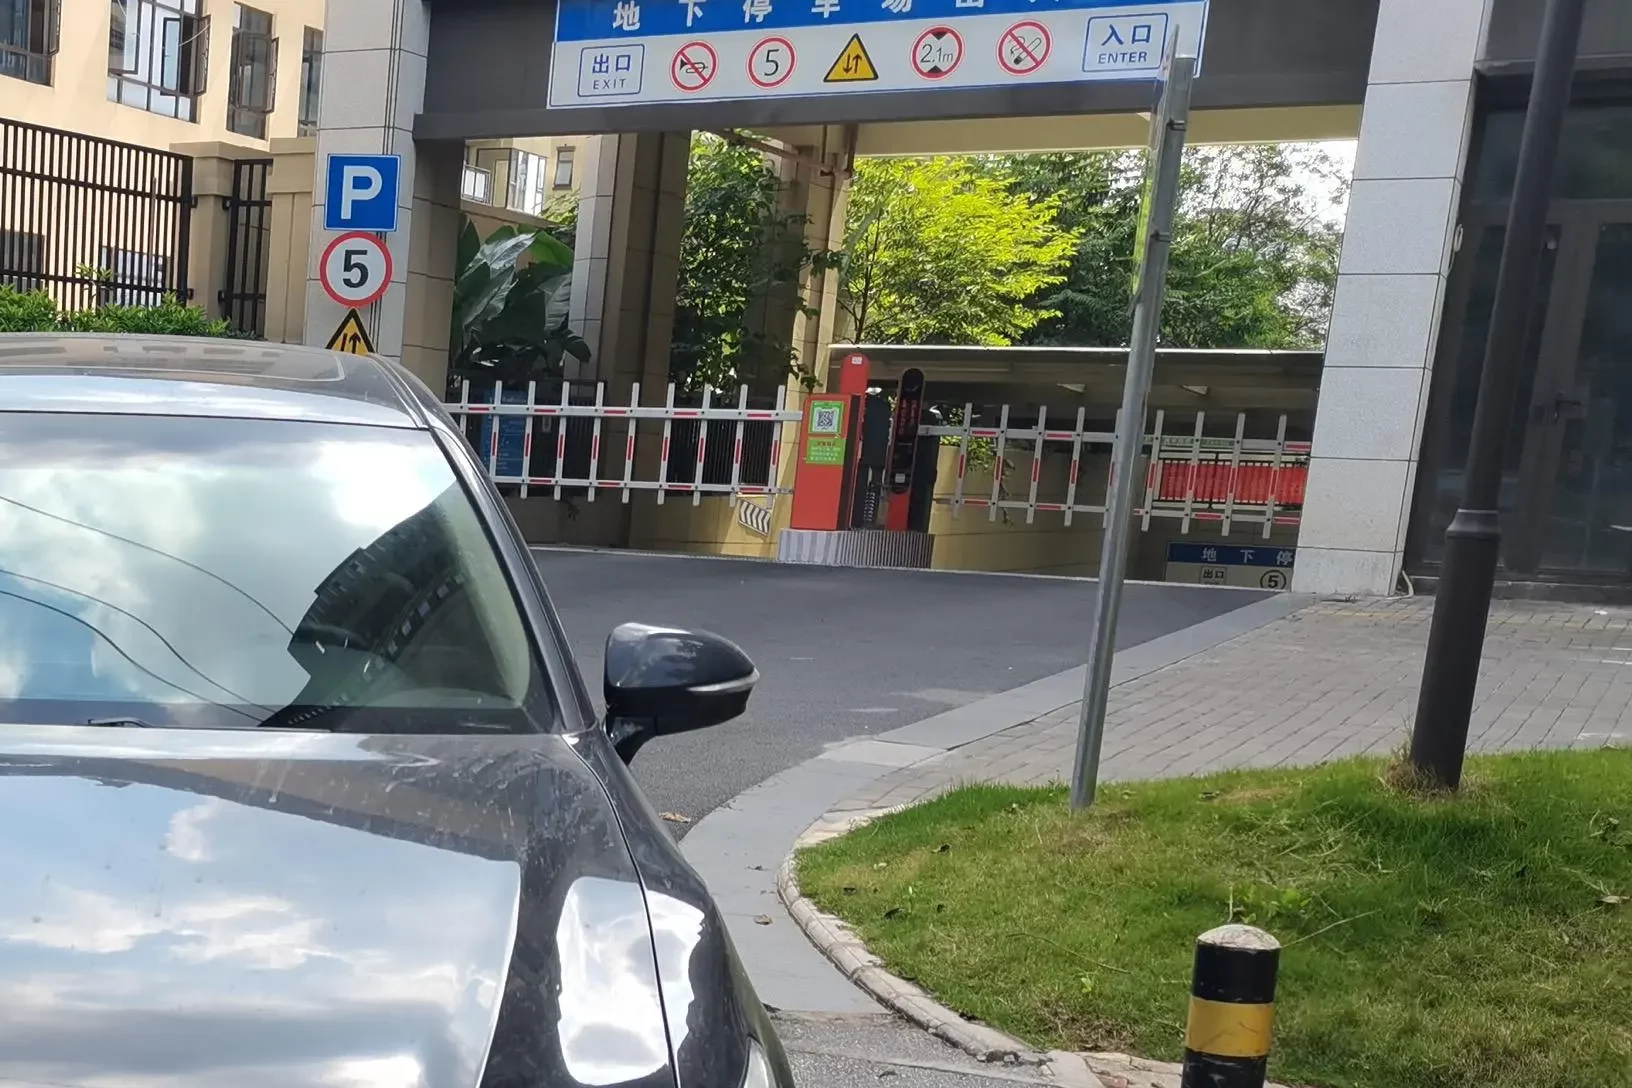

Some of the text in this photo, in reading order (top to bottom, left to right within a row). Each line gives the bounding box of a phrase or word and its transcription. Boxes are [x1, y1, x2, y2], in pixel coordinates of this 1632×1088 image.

[1101, 24, 1151, 46] 入口
[592, 53, 630, 73] 出口
[764, 49, 780, 76] 5
[920, 43, 954, 64] 2.1m
[1098, 51, 1147, 64] ENTER
[593, 78, 626, 89] EXIT
[341, 165, 383, 219] P
[342, 249, 369, 288] 5
[1268, 575, 1279, 588] 5
